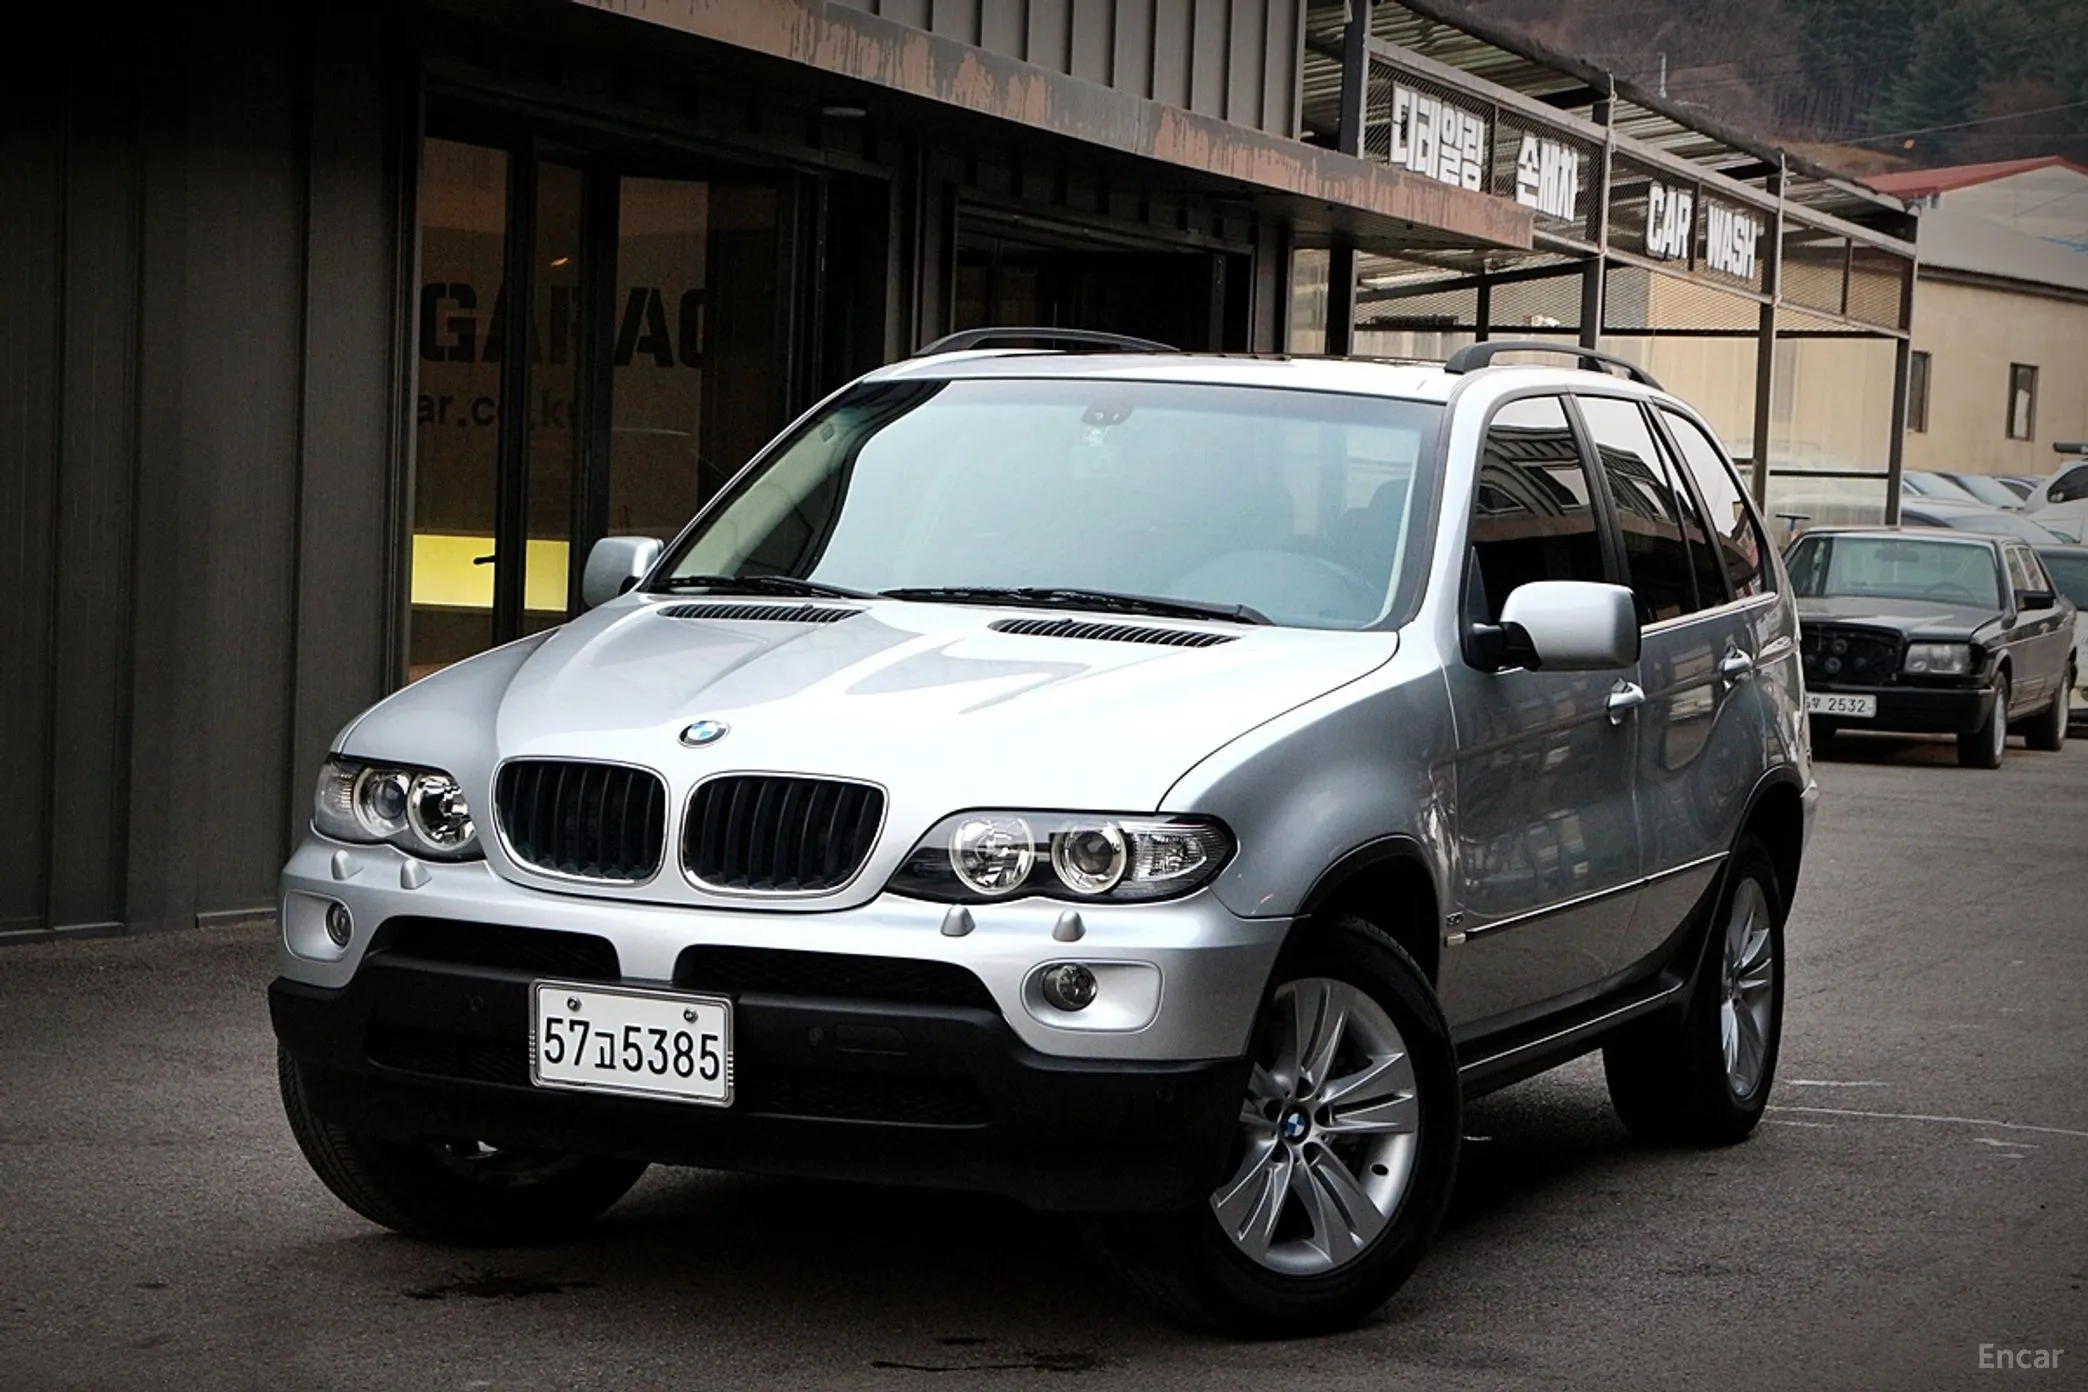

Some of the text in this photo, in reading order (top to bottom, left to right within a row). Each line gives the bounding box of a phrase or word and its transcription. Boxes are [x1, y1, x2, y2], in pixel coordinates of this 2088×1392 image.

[1390, 85, 1757, 279] 디테일링 손세차 CAR WASH
[1828, 697, 1867, 713] 2532
[544, 1016, 720, 1081] 57고5385
